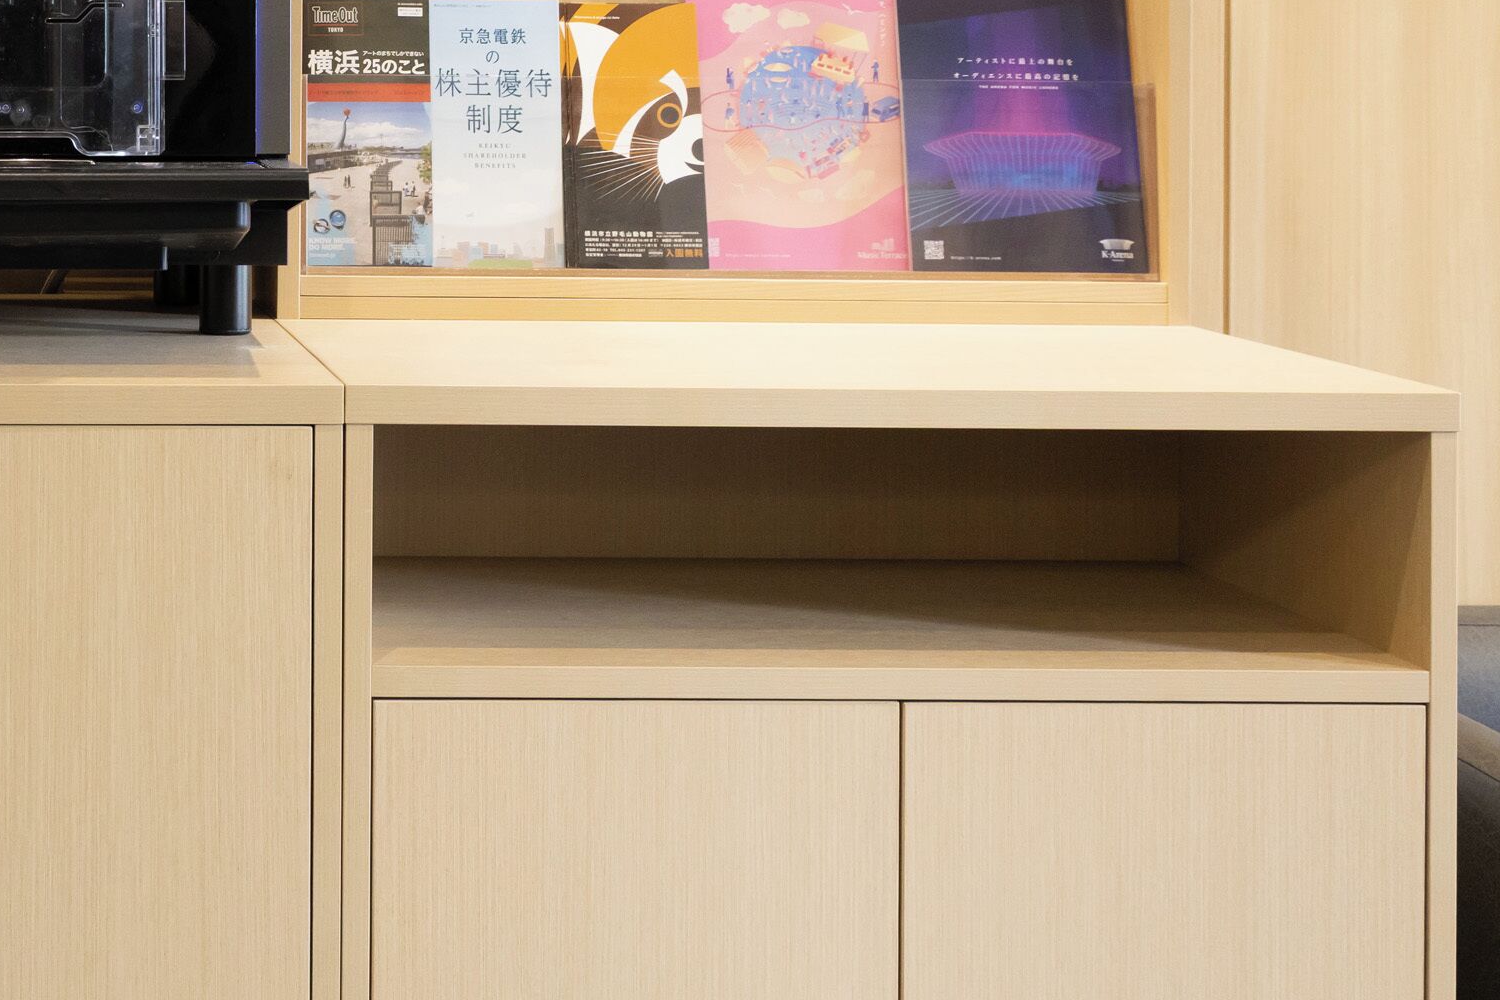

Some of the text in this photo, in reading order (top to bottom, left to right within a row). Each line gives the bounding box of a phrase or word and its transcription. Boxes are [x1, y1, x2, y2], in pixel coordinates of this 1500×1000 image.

[458, 27, 527, 45] 京急電鉄
[308, 49, 426, 75] 横浜 25のこと
[485, 49, 500, 64] の
[434, 67, 553, 98] 株主優待
[465, 103, 524, 134] 制度
[463, 152, 527, 160] SHAREHOLDER
[1101, 250, 1134, 259] K-Arena
